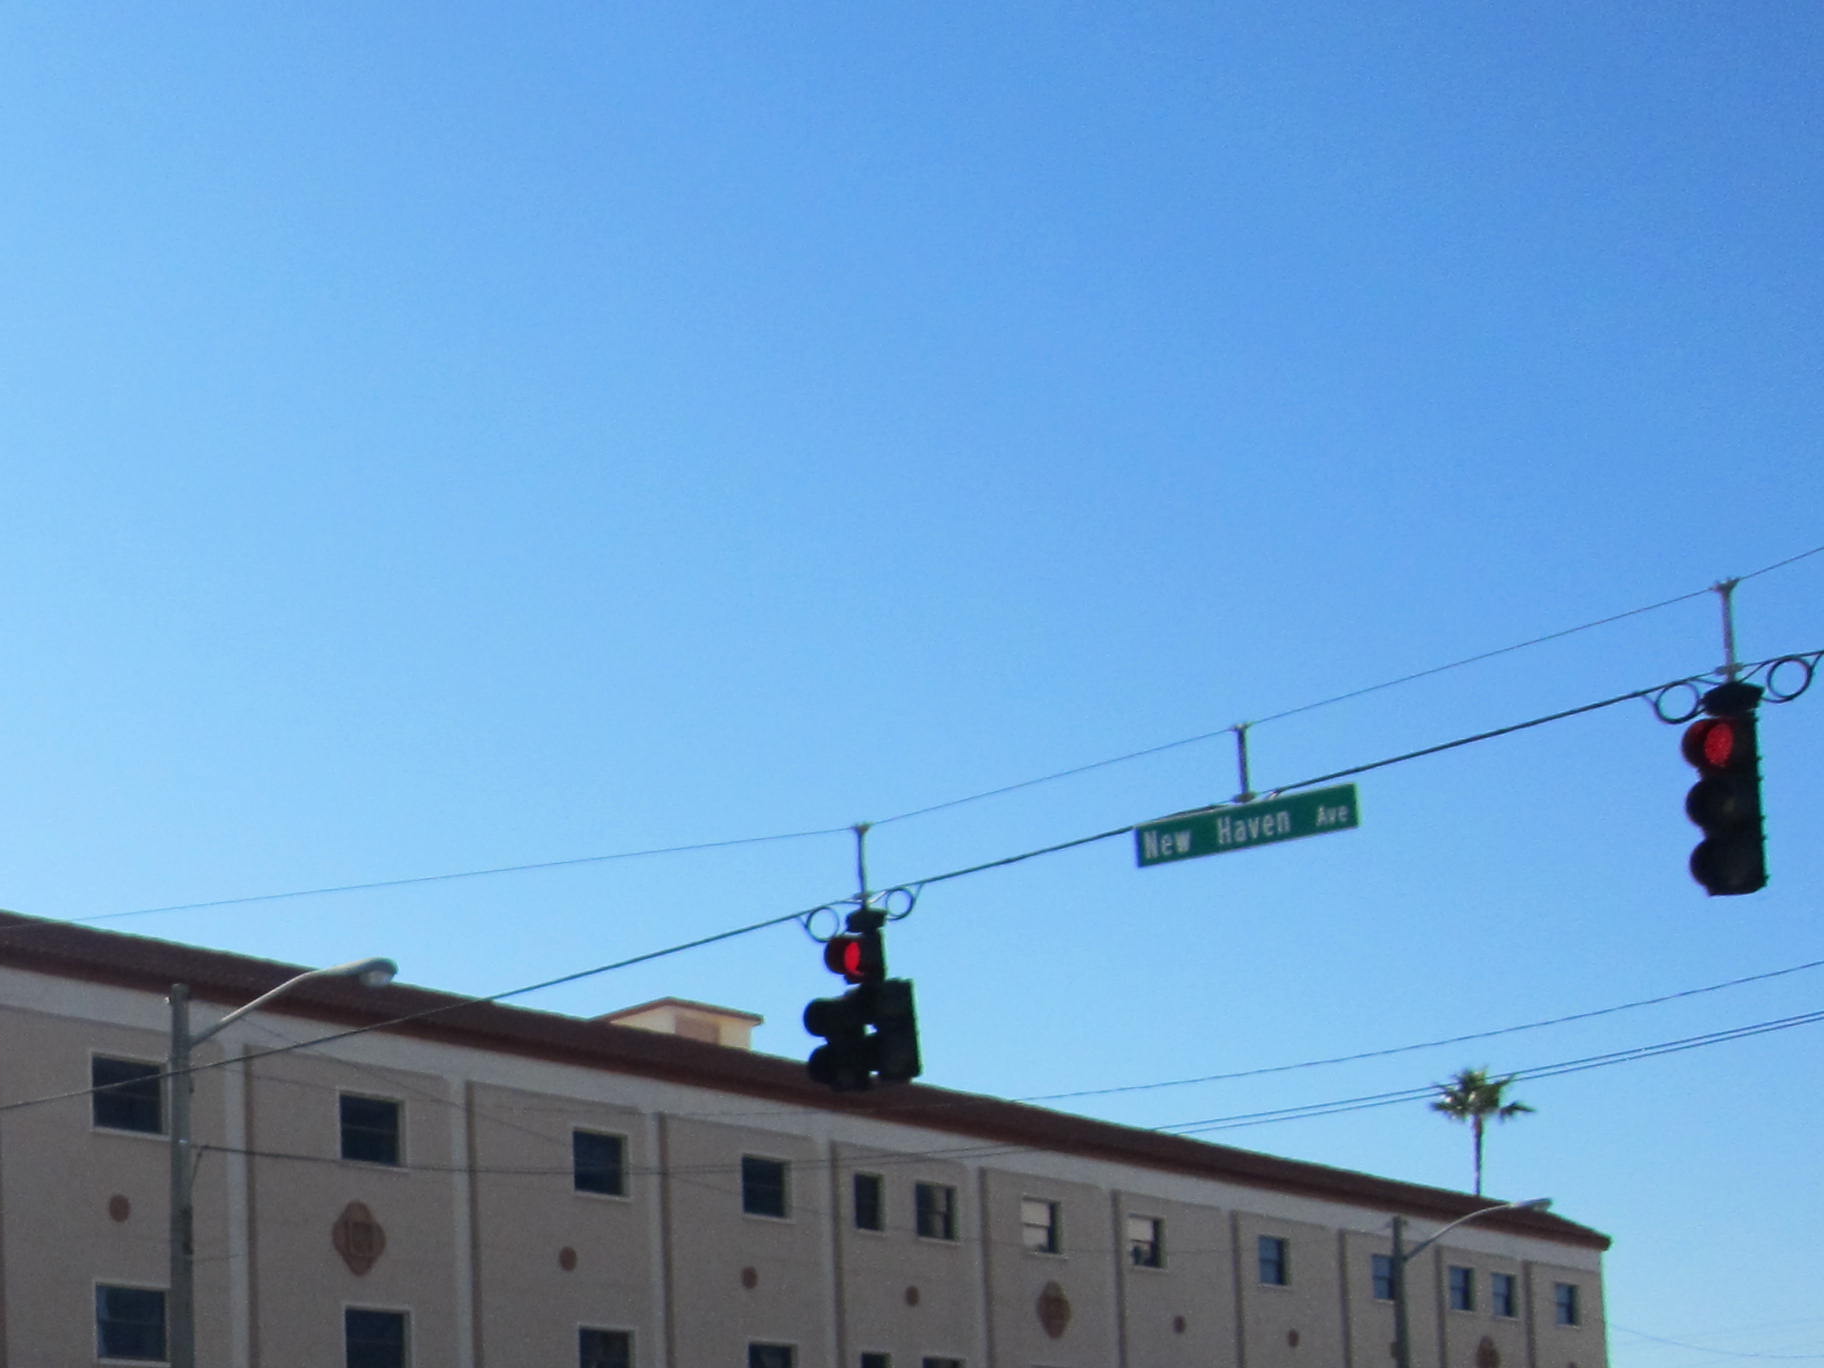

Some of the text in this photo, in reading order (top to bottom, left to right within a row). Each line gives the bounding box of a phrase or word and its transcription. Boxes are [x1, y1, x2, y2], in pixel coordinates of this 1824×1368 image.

[1143, 804, 1349, 859] New Haven Ave
